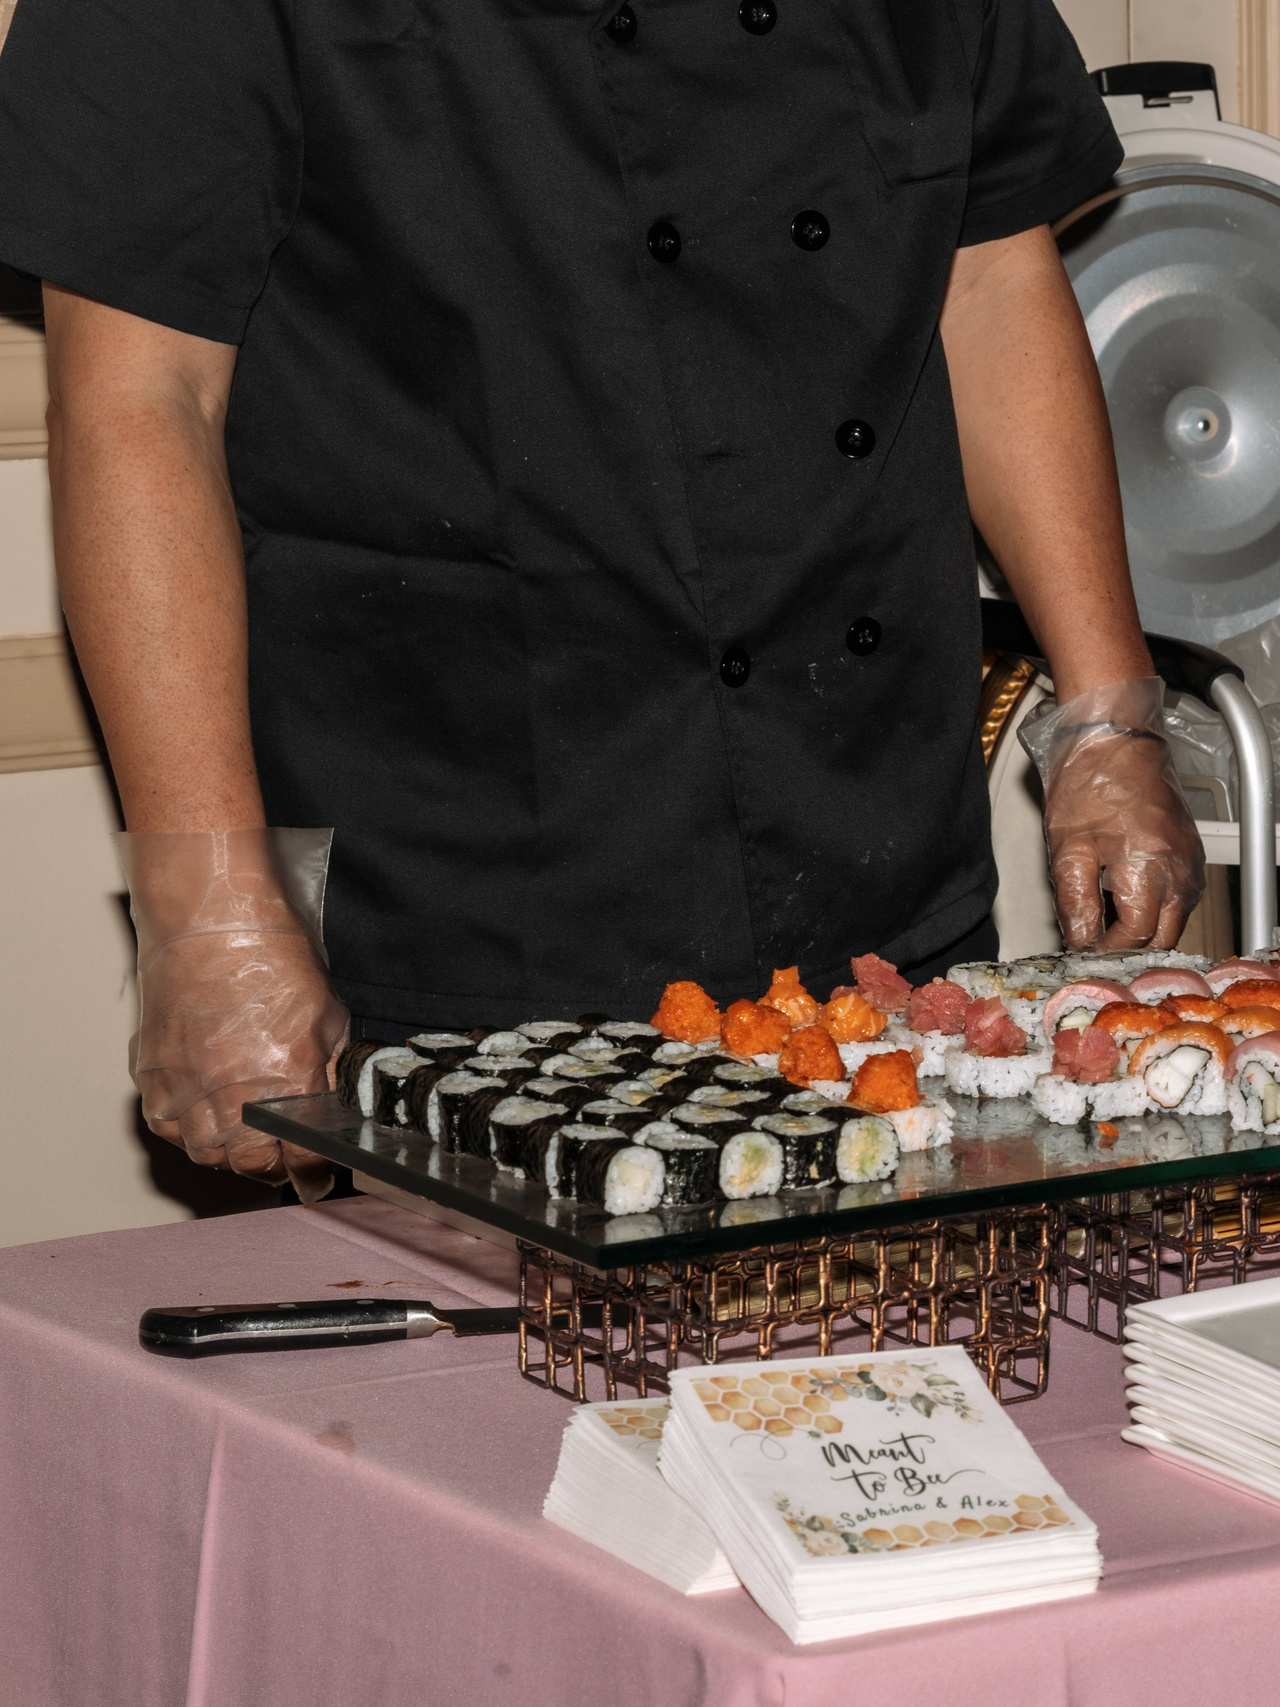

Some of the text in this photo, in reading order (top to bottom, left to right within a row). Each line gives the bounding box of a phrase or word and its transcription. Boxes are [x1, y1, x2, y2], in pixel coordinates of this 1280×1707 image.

[821, 1432, 936, 1467] Meant
[830, 1467, 986, 1501] to Bee
[839, 1495, 1010, 1528] Sabrina & Alex
